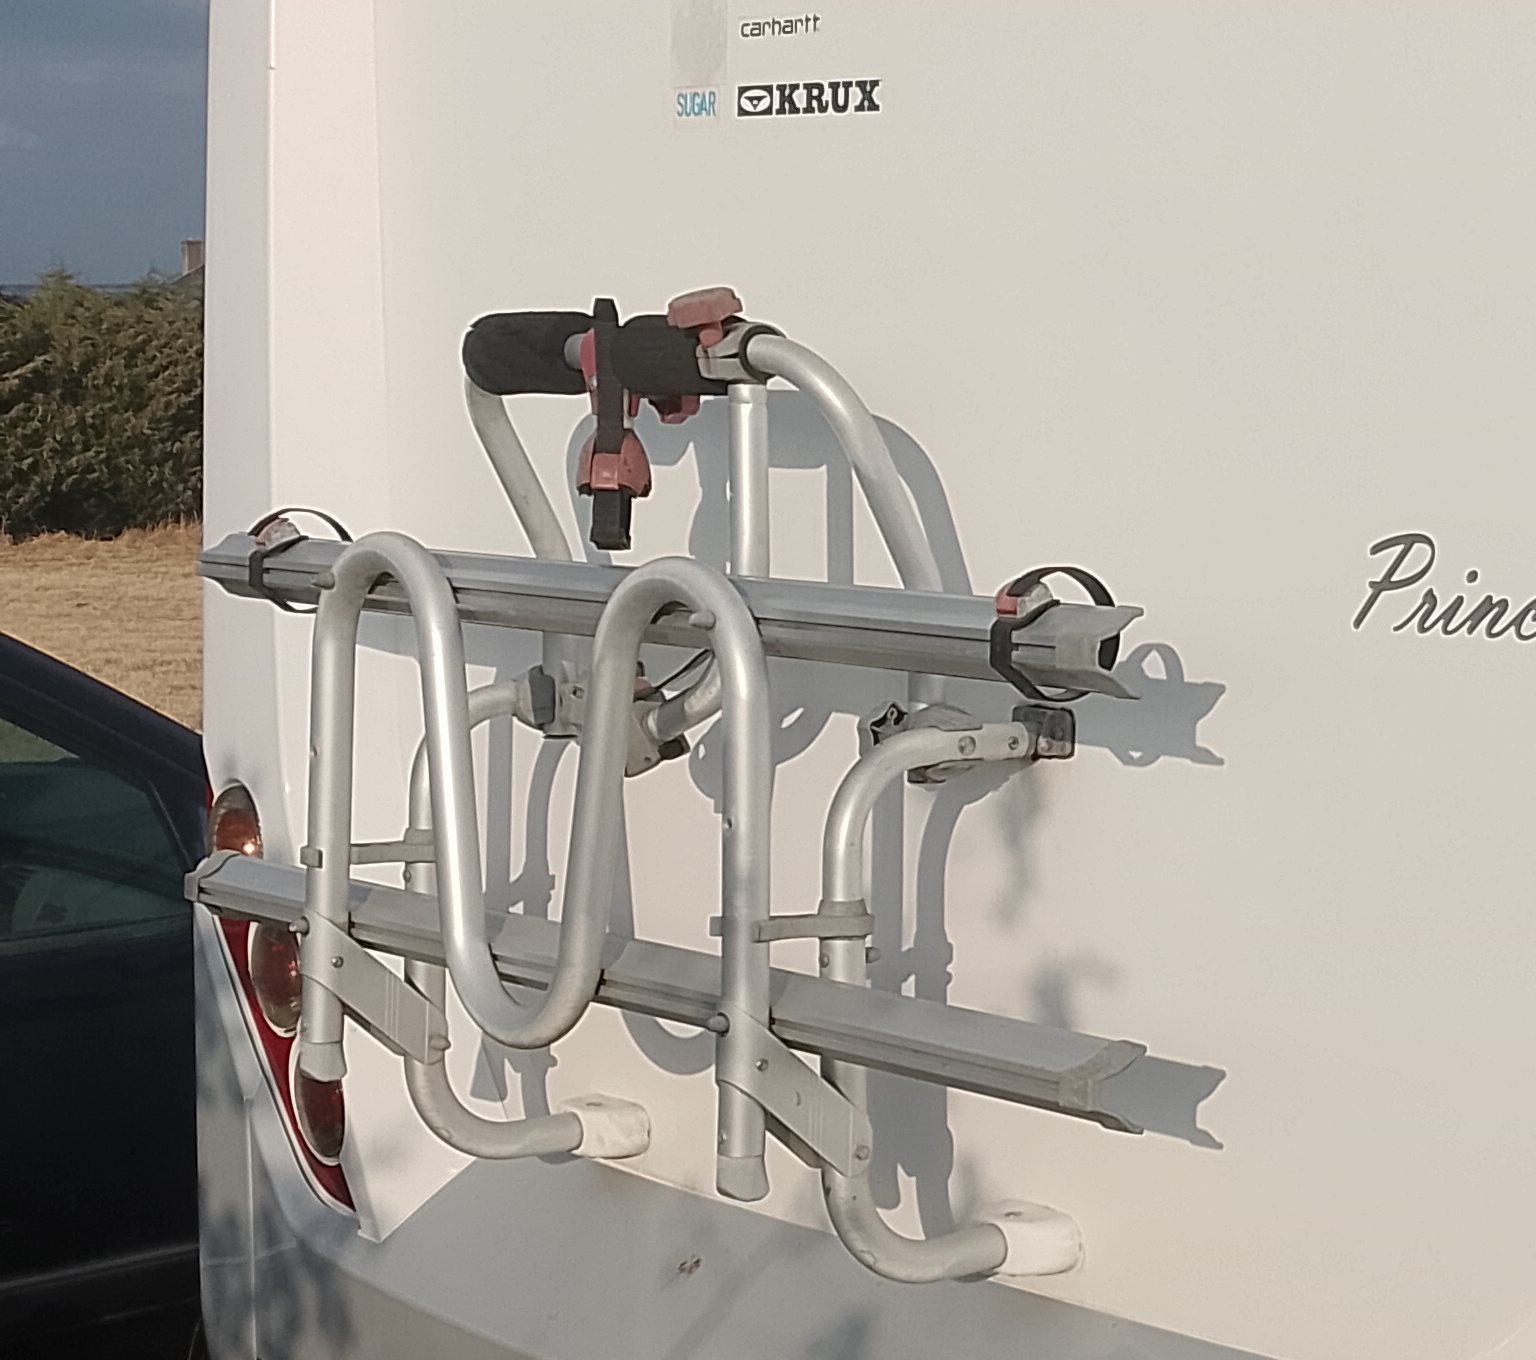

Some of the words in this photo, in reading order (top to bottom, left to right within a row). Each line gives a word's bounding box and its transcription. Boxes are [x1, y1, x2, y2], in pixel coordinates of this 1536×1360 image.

[740, 14, 820, 38] carhartt
[677, 91, 717, 117] SUGAR
[775, 79, 881, 115] KRUX
